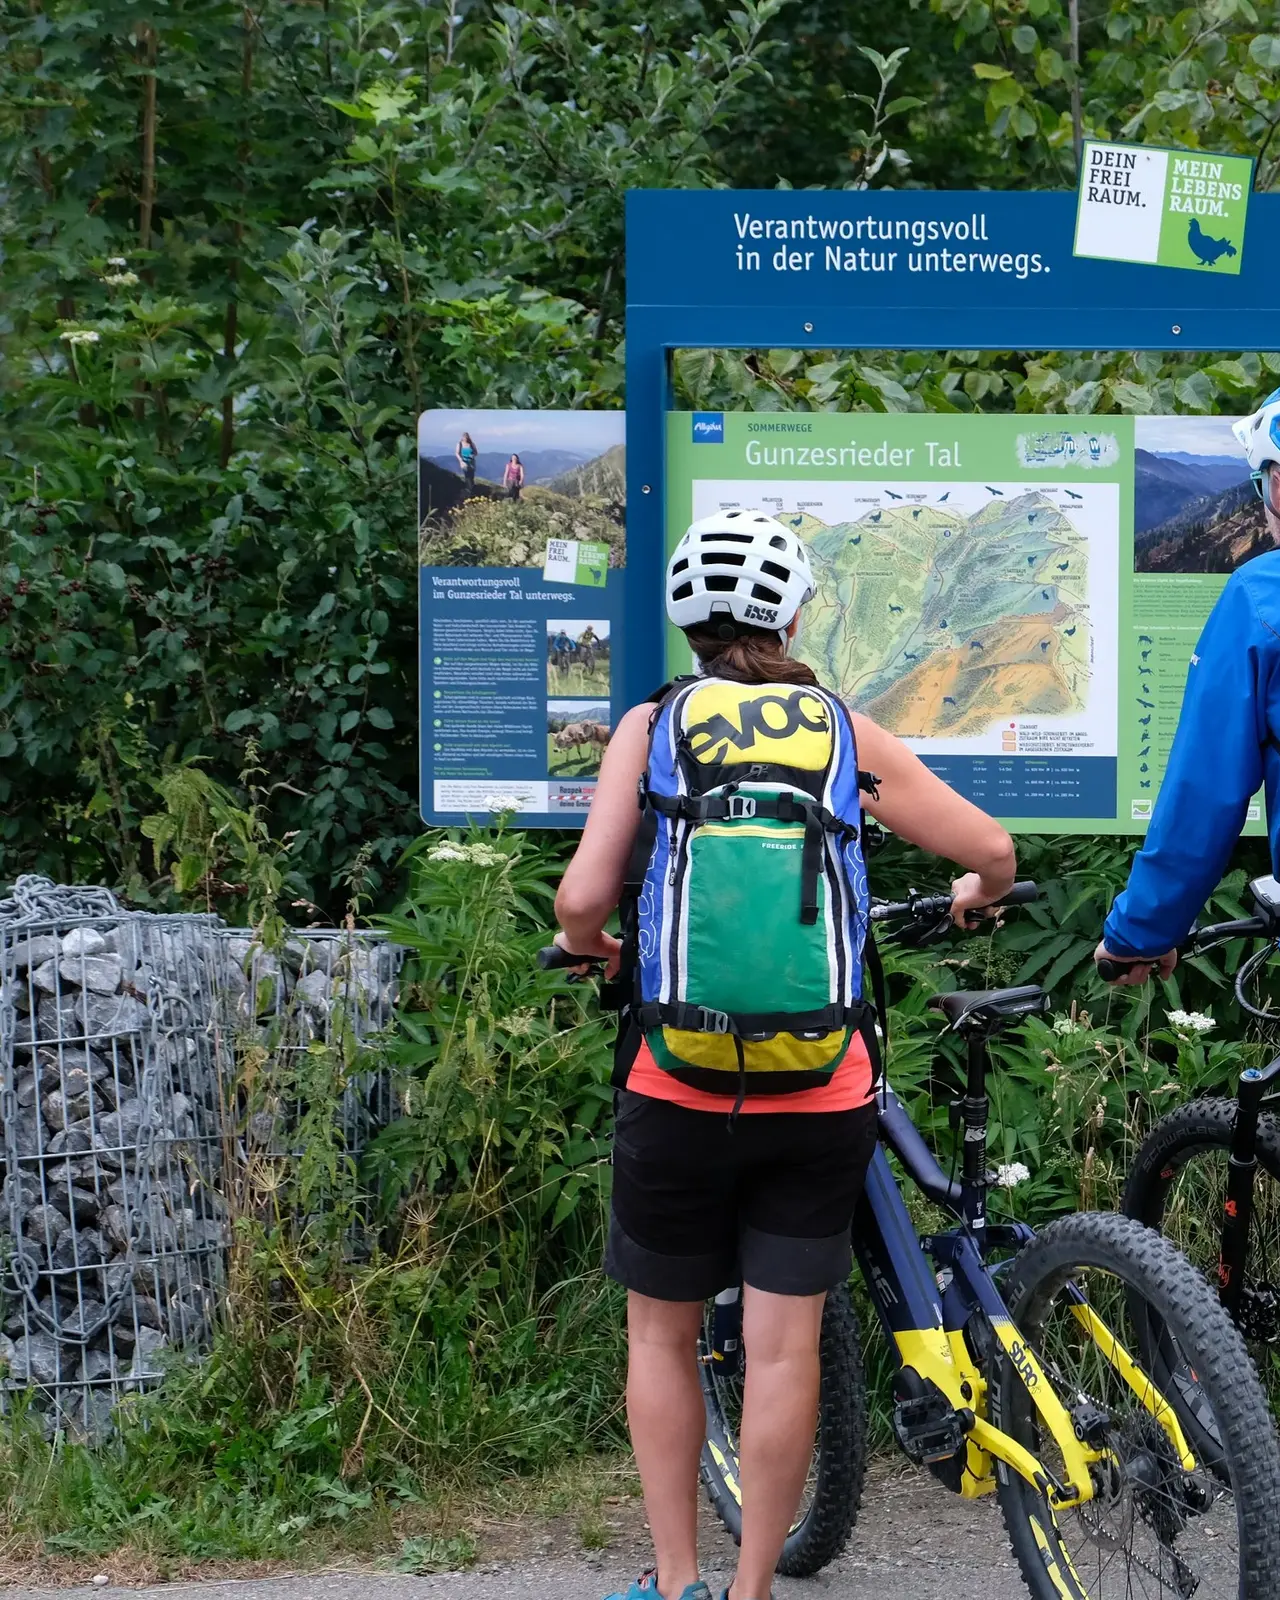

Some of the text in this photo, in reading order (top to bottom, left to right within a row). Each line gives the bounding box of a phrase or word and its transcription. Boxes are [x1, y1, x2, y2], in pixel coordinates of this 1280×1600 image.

[1091, 149, 1137, 170] DEIN
[1173, 159, 1224, 180] MEIN
[1089, 168, 1132, 188] FREI
[1171, 177, 1243, 201] LEBENS
[1087, 186, 1147, 208] RAUM.
[1169, 195, 1230, 218] RAUM.
[733, 212, 989, 247] Verantwortungsvoll
[735, 244, 1051, 280] in der Natur unterwegs.
[747, 422, 813, 433] SOMMERWEGE
[744, 440, 962, 468] Gunzesrieder Tal
[432, 576, 521, 588] Verantwortungsvoll
[433, 590, 576, 602] im Gunzesrieder Tal unterwegs.
[686, 690, 830, 765] evoc
[761, 842, 798, 850] FREERIDE
[1141, 1125, 1220, 1174] SCHWALBE
[1008, 1340, 1039, 1388] SDURO
